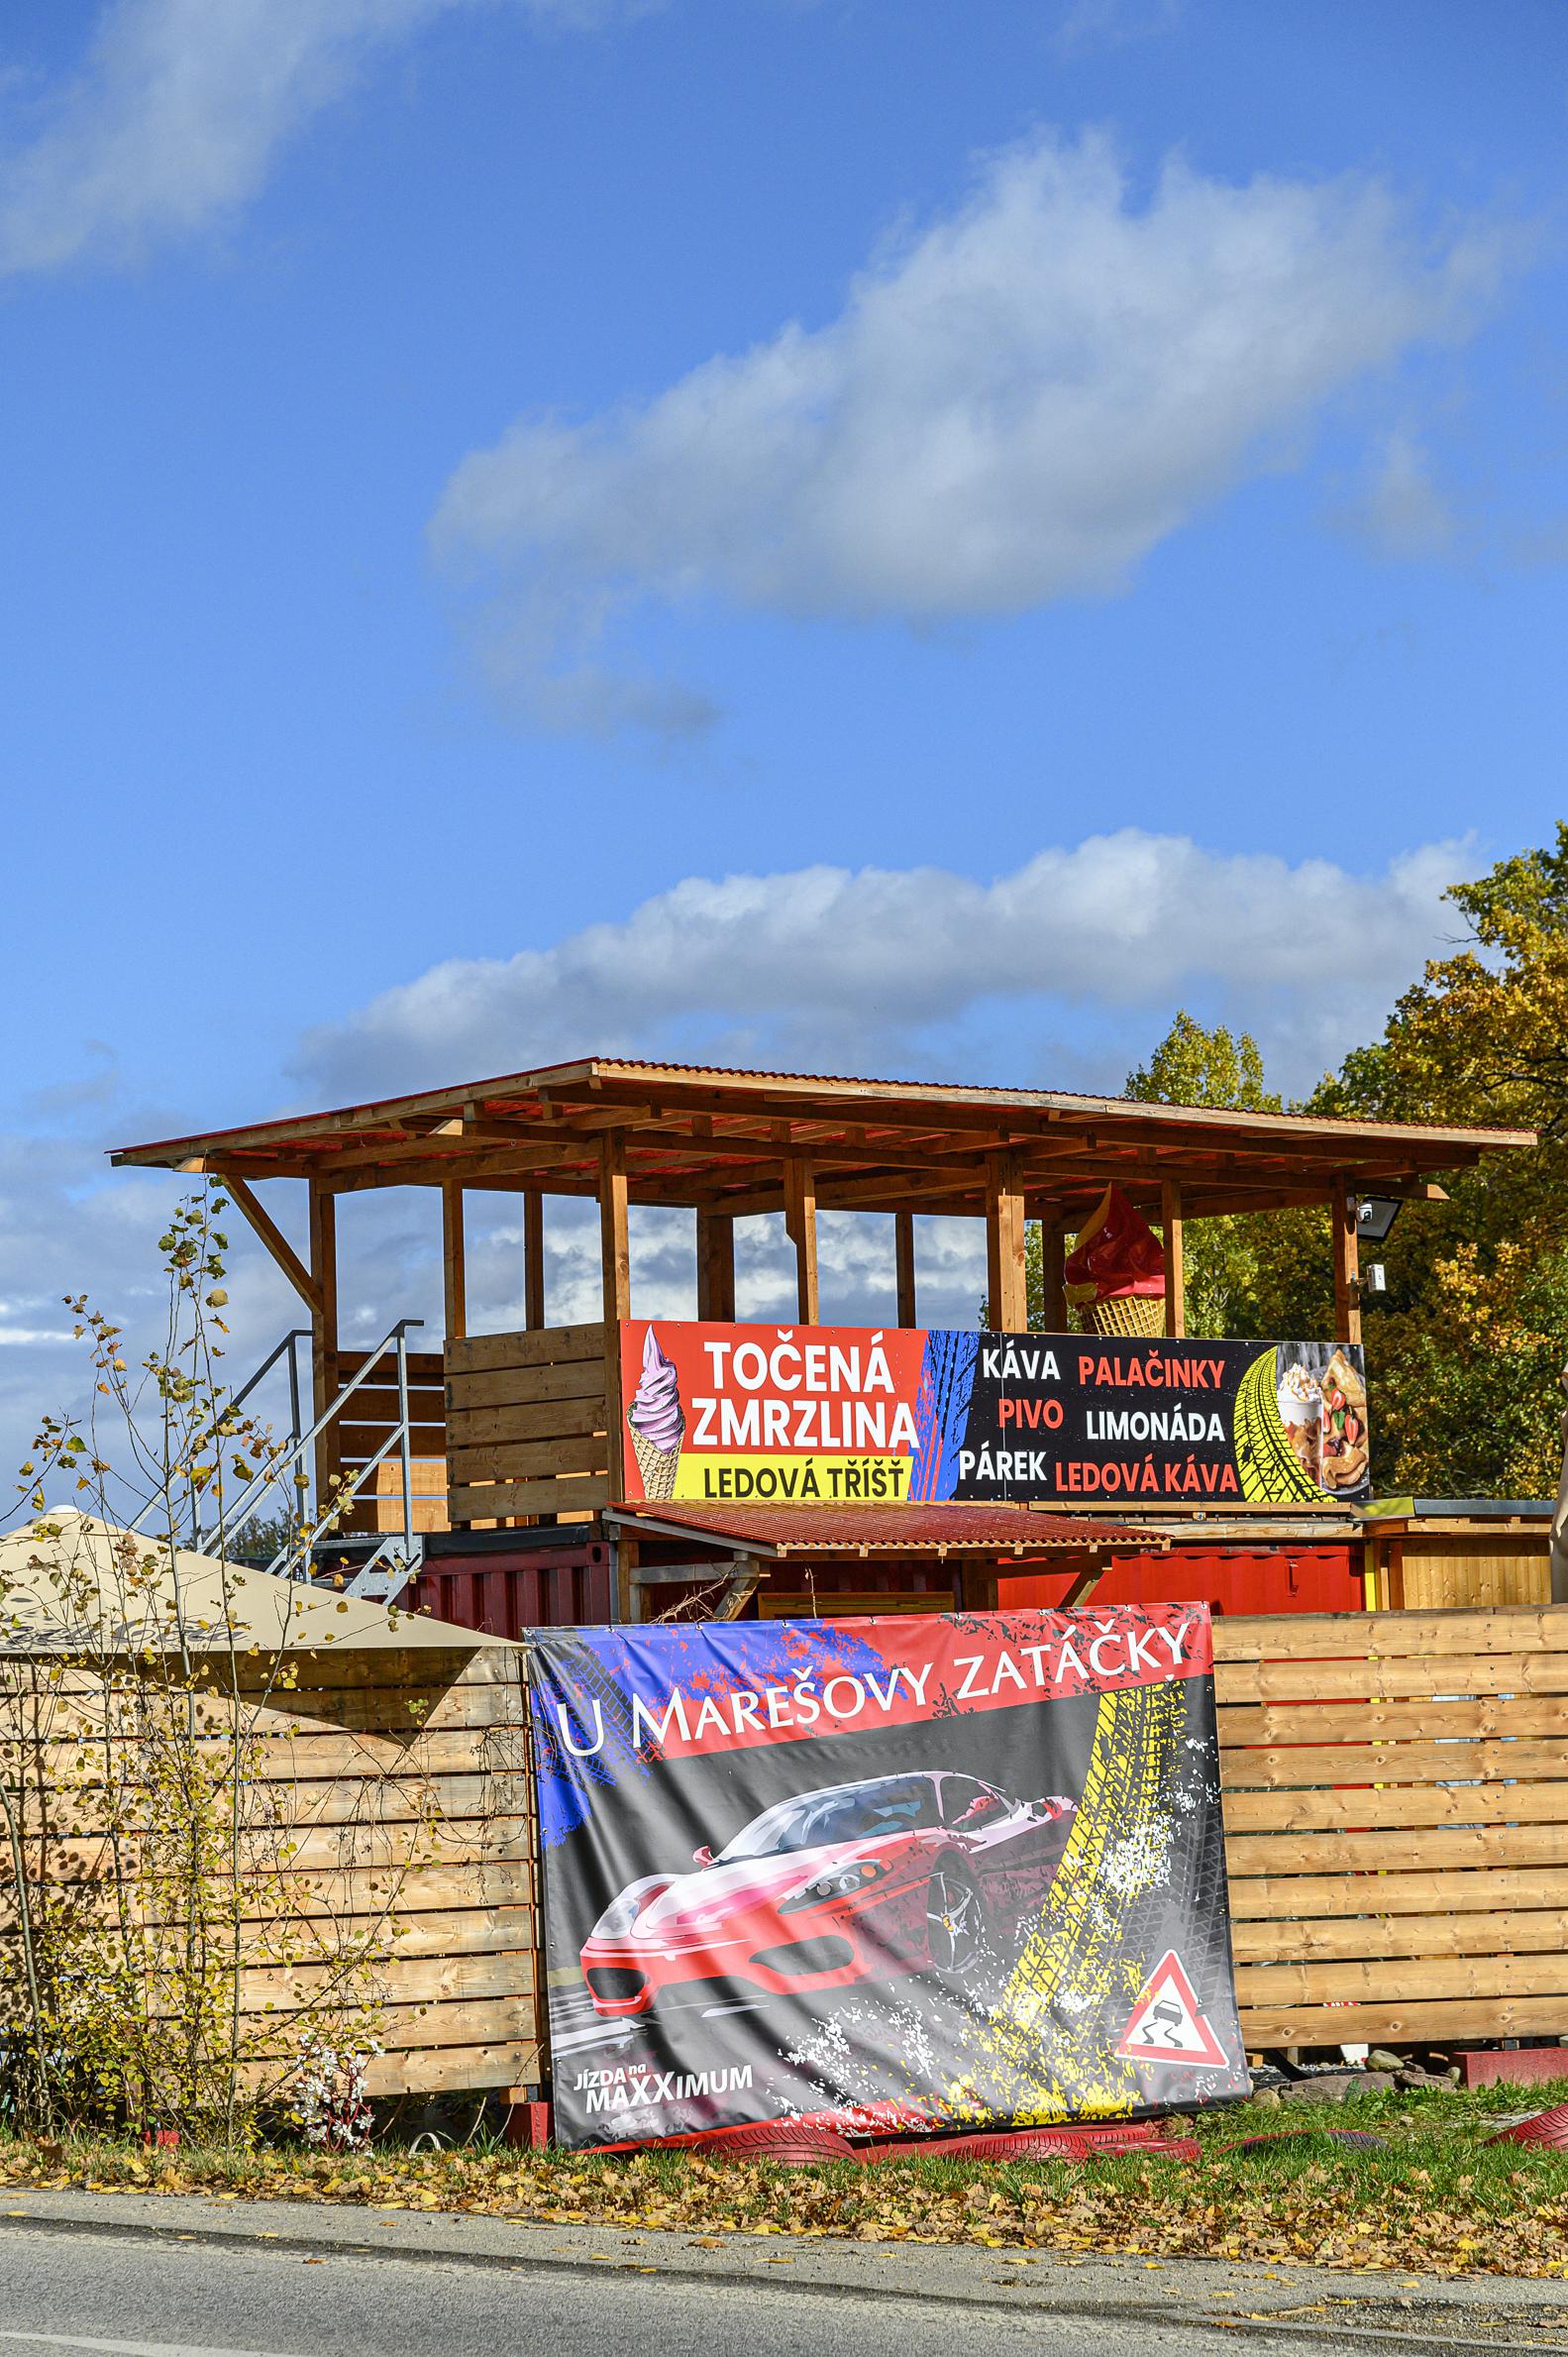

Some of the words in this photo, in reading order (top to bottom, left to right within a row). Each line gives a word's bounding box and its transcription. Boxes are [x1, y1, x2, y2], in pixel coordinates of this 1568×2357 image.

[704, 1328, 895, 1393] TOČENÁ
[983, 1339, 1061, 1380] KÁVA
[1078, 1348, 1225, 1388] PALAČINKY
[691, 1397, 921, 1448] ZMRZLINA
[998, 1398, 1064, 1430] PIVO
[1086, 1402, 1225, 1443] LIMONÁDA
[703, 1456, 821, 1499] LEDOVÁ
[827, 1457, 904, 1498] TŘÍŠŤ
[958, 1440, 1048, 1481] PÁREK
[1055, 1453, 1160, 1492] LEDOVÁ
[1165, 1453, 1238, 1493] KÁVA
[556, 1699, 604, 1757] U
[953, 1618, 1191, 1701] ZATÁČKY
[574, 2067, 626, 2091] JÍZDA
[628, 2063, 647, 2077] na
[585, 2064, 753, 2113] MAXXIMUM
